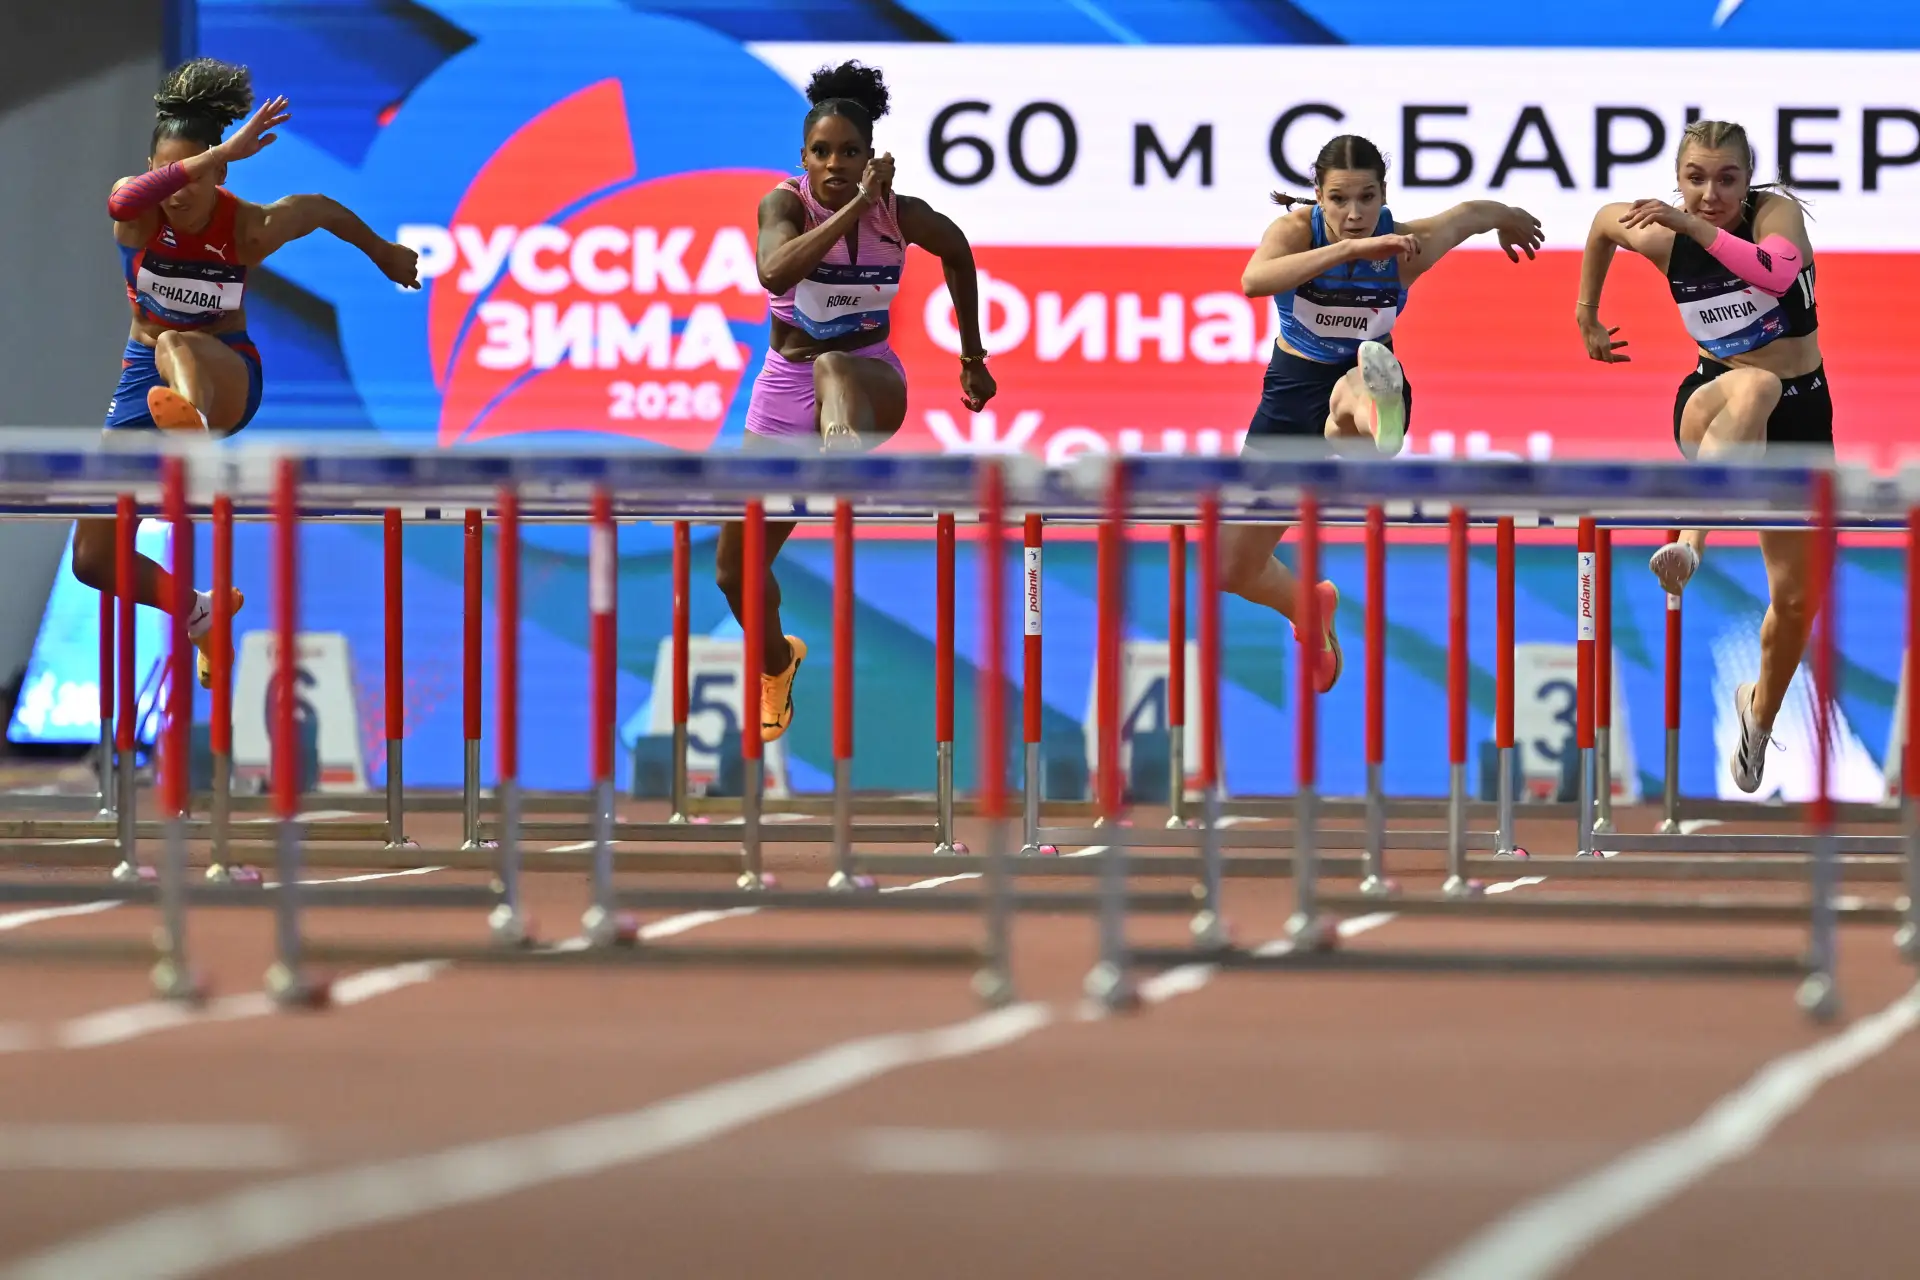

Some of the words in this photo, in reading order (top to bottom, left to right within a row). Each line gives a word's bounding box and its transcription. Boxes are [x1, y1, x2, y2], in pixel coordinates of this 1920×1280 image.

[928, 100, 1077, 186] 60
[1133, 124, 1213, 186] м
[1402, 104, 1920, 193] БАРЕР
[151, 281, 223, 310] ECHAZABAL
[826, 294, 861, 308] ROBLE
[924, 269, 1281, 365] Фина
[1699, 301, 1757, 325] RATIYEVA
[476, 302, 744, 370] ЗИМА
[1315, 313, 1368, 331] OSIPOVA
[608, 382, 723, 420] 2026
[1028, 568, 1039, 613] polanik
[1580, 573, 1592, 618] polanik
[688, 673, 742, 757] 5
[1534, 679, 1578, 761] 3
